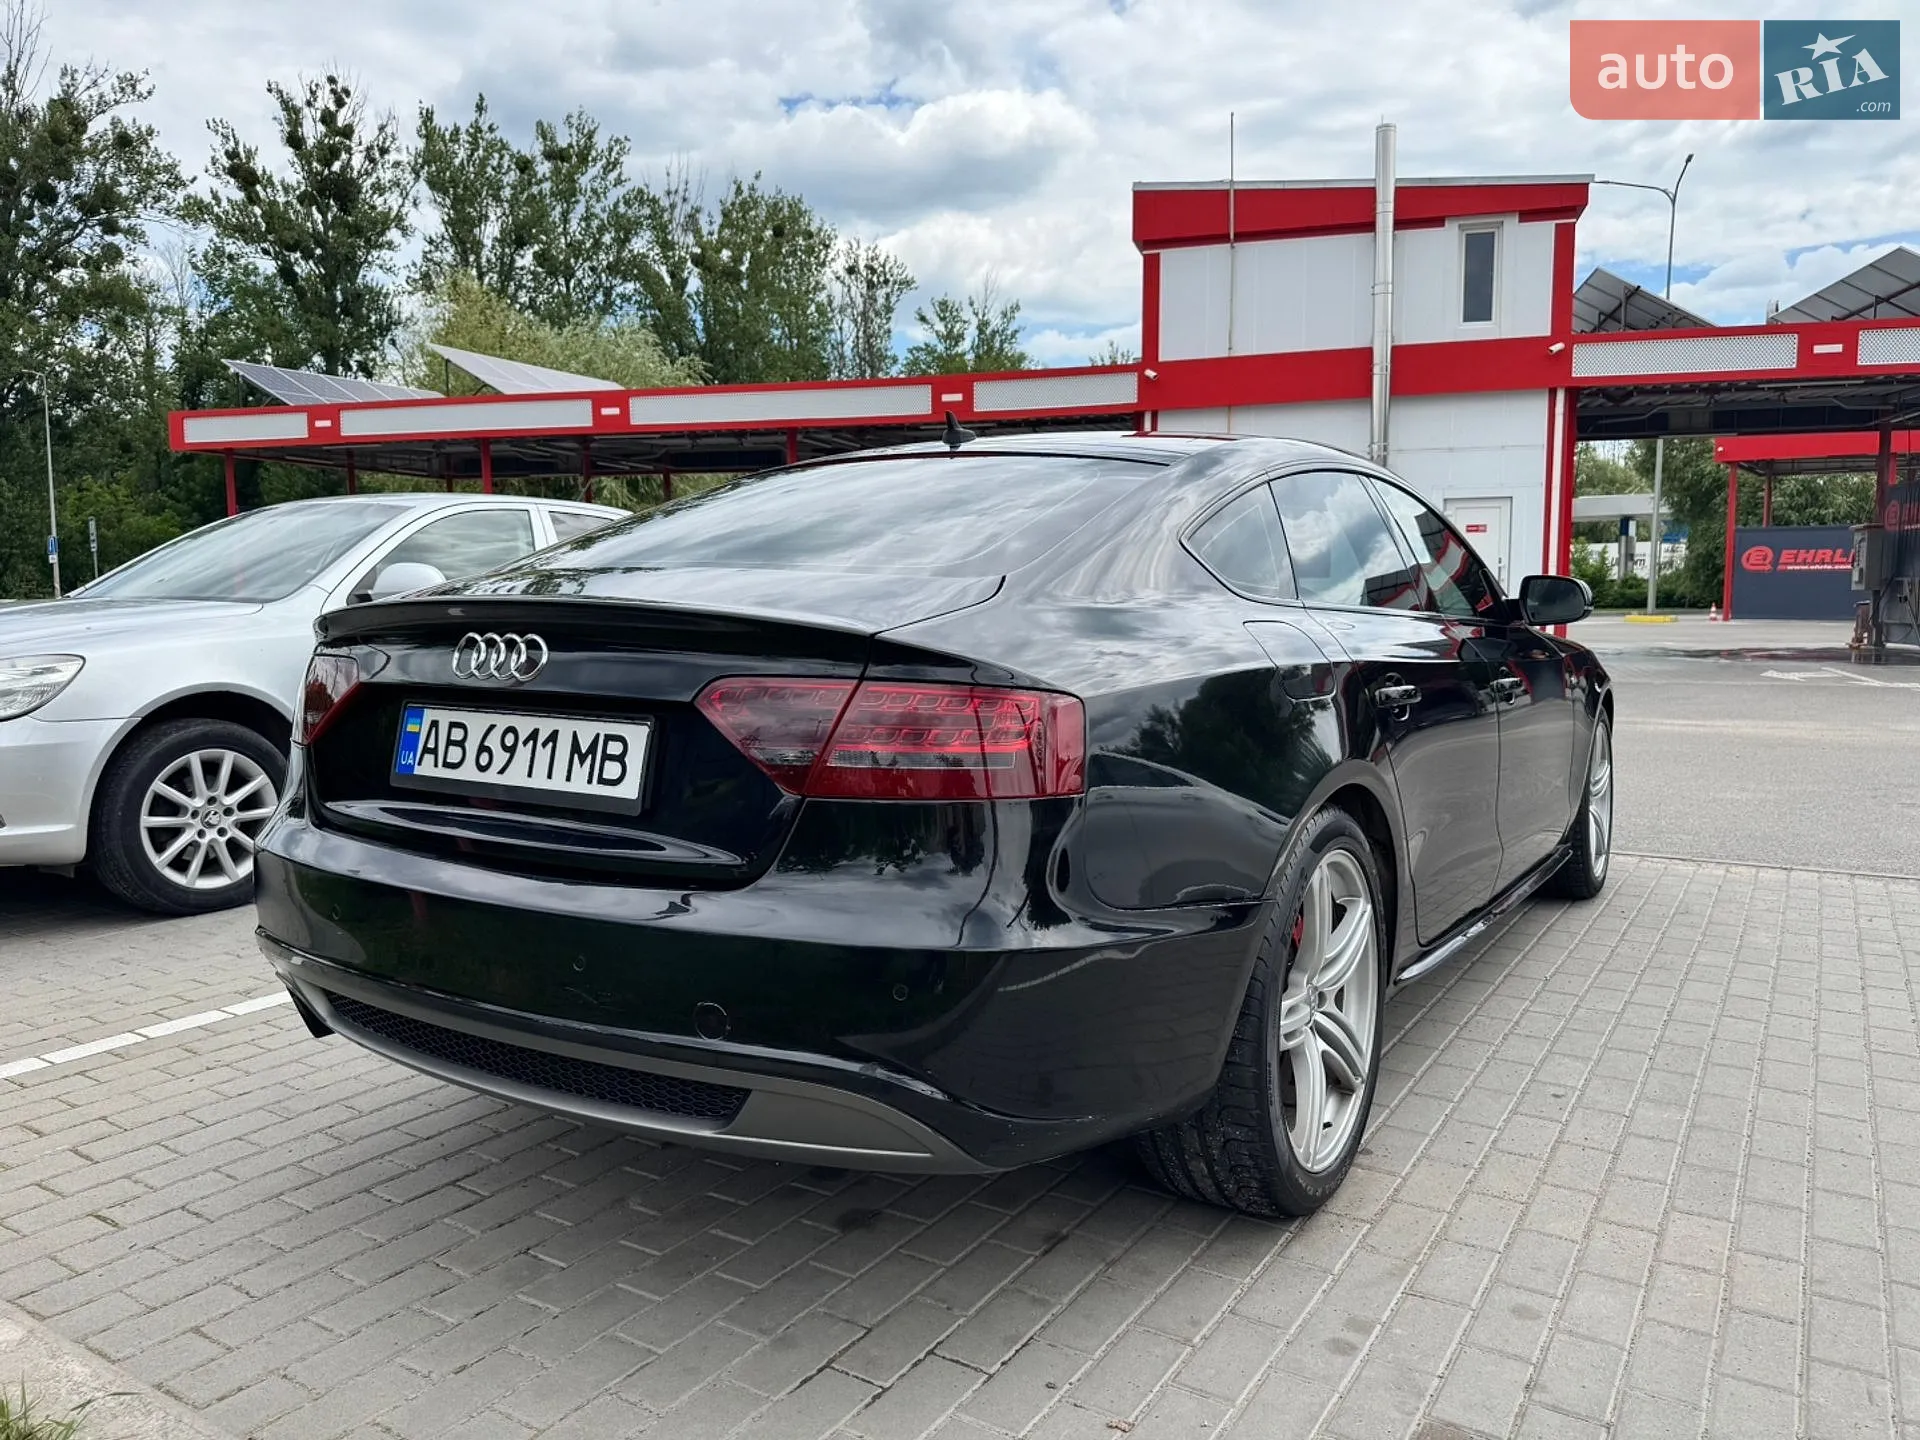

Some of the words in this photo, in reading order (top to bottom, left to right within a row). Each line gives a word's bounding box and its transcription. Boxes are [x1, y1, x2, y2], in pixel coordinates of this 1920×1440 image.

[1779, 549, 1855, 563] EHRL
[400, 751, 415, 766] UA
[417, 719, 468, 770] AB
[474, 723, 560, 780] 6911
[565, 730, 629, 787] MB
